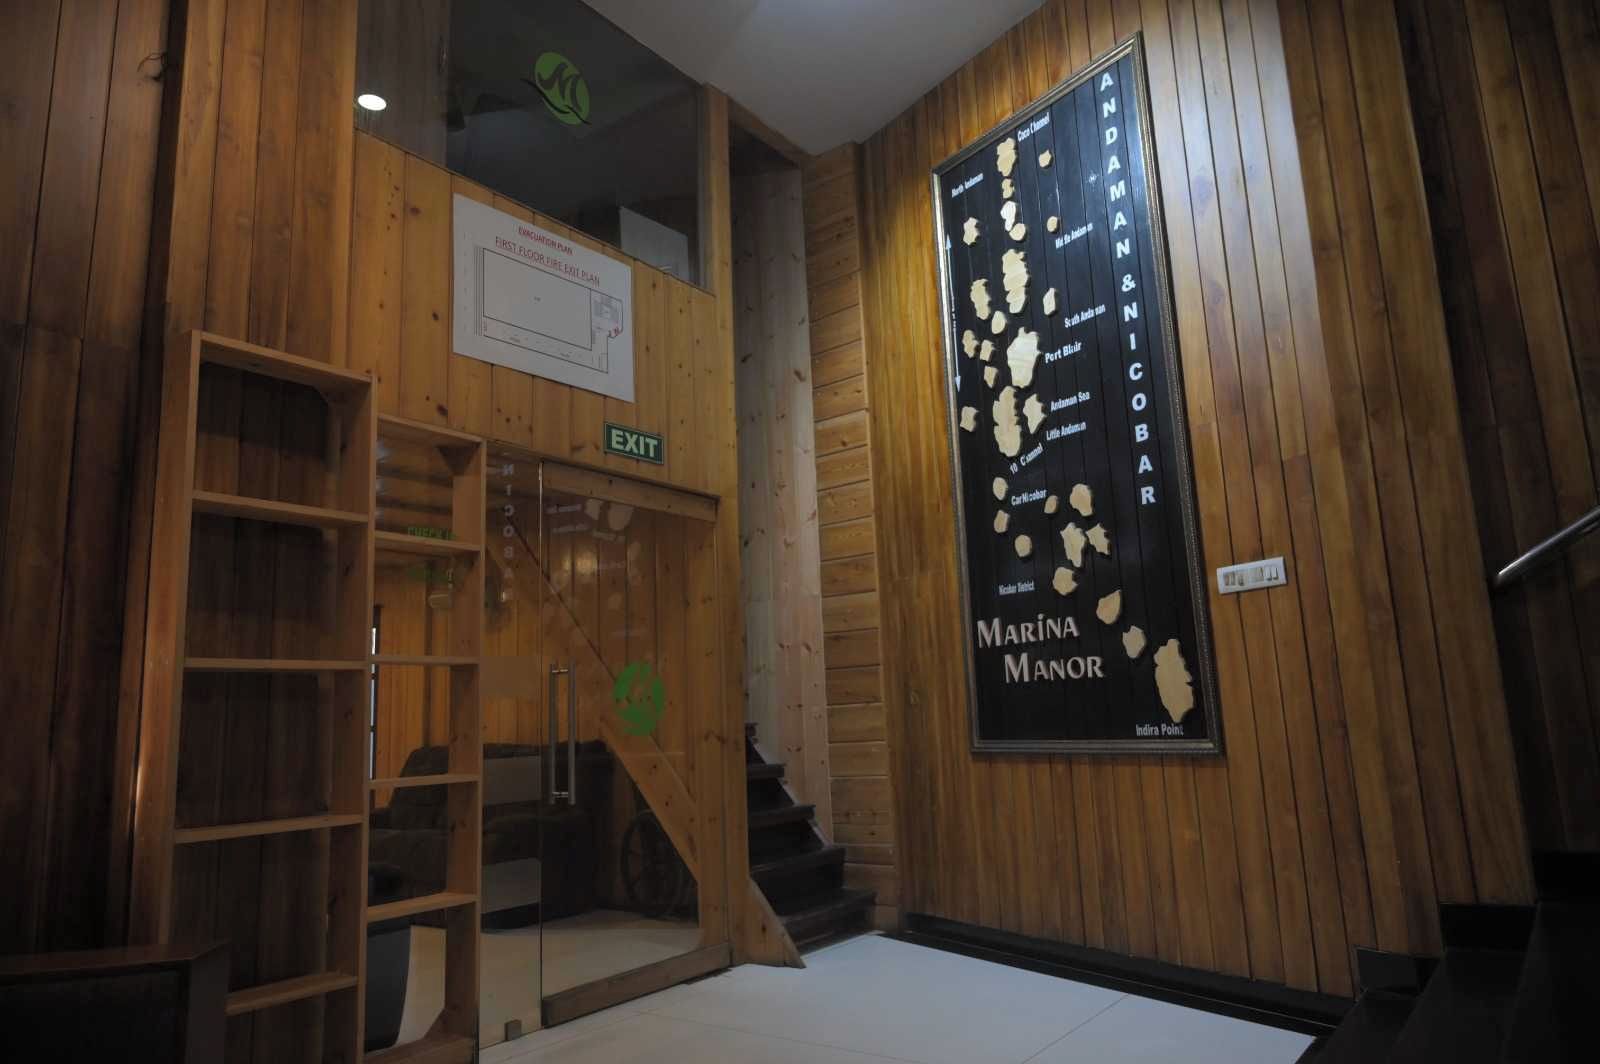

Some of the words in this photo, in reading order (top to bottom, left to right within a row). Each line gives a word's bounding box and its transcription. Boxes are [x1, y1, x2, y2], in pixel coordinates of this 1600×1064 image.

[1100, 72, 1131, 259] ANDAMAN
[518, 225, 557, 249] EVACUATION
[557, 243, 573, 256] PLAN
[495, 235, 516, 254] FIRST
[518, 246, 545, 264] FLOOR
[546, 256, 562, 272] FIRE
[564, 263, 580, 278] EXIT
[581, 269, 600, 288] PLAN
[1121, 273, 1136, 292] &
[1045, 348, 1062, 363] Port
[1062, 341, 1082, 356] Blair
[1077, 391, 1091, 402] Sea
[1123, 302, 1156, 505] NICOBAR
[611, 428, 658, 458] EXIT
[1135, 723, 1160, 736] Indira
[1161, 723, 1184, 736] Point
